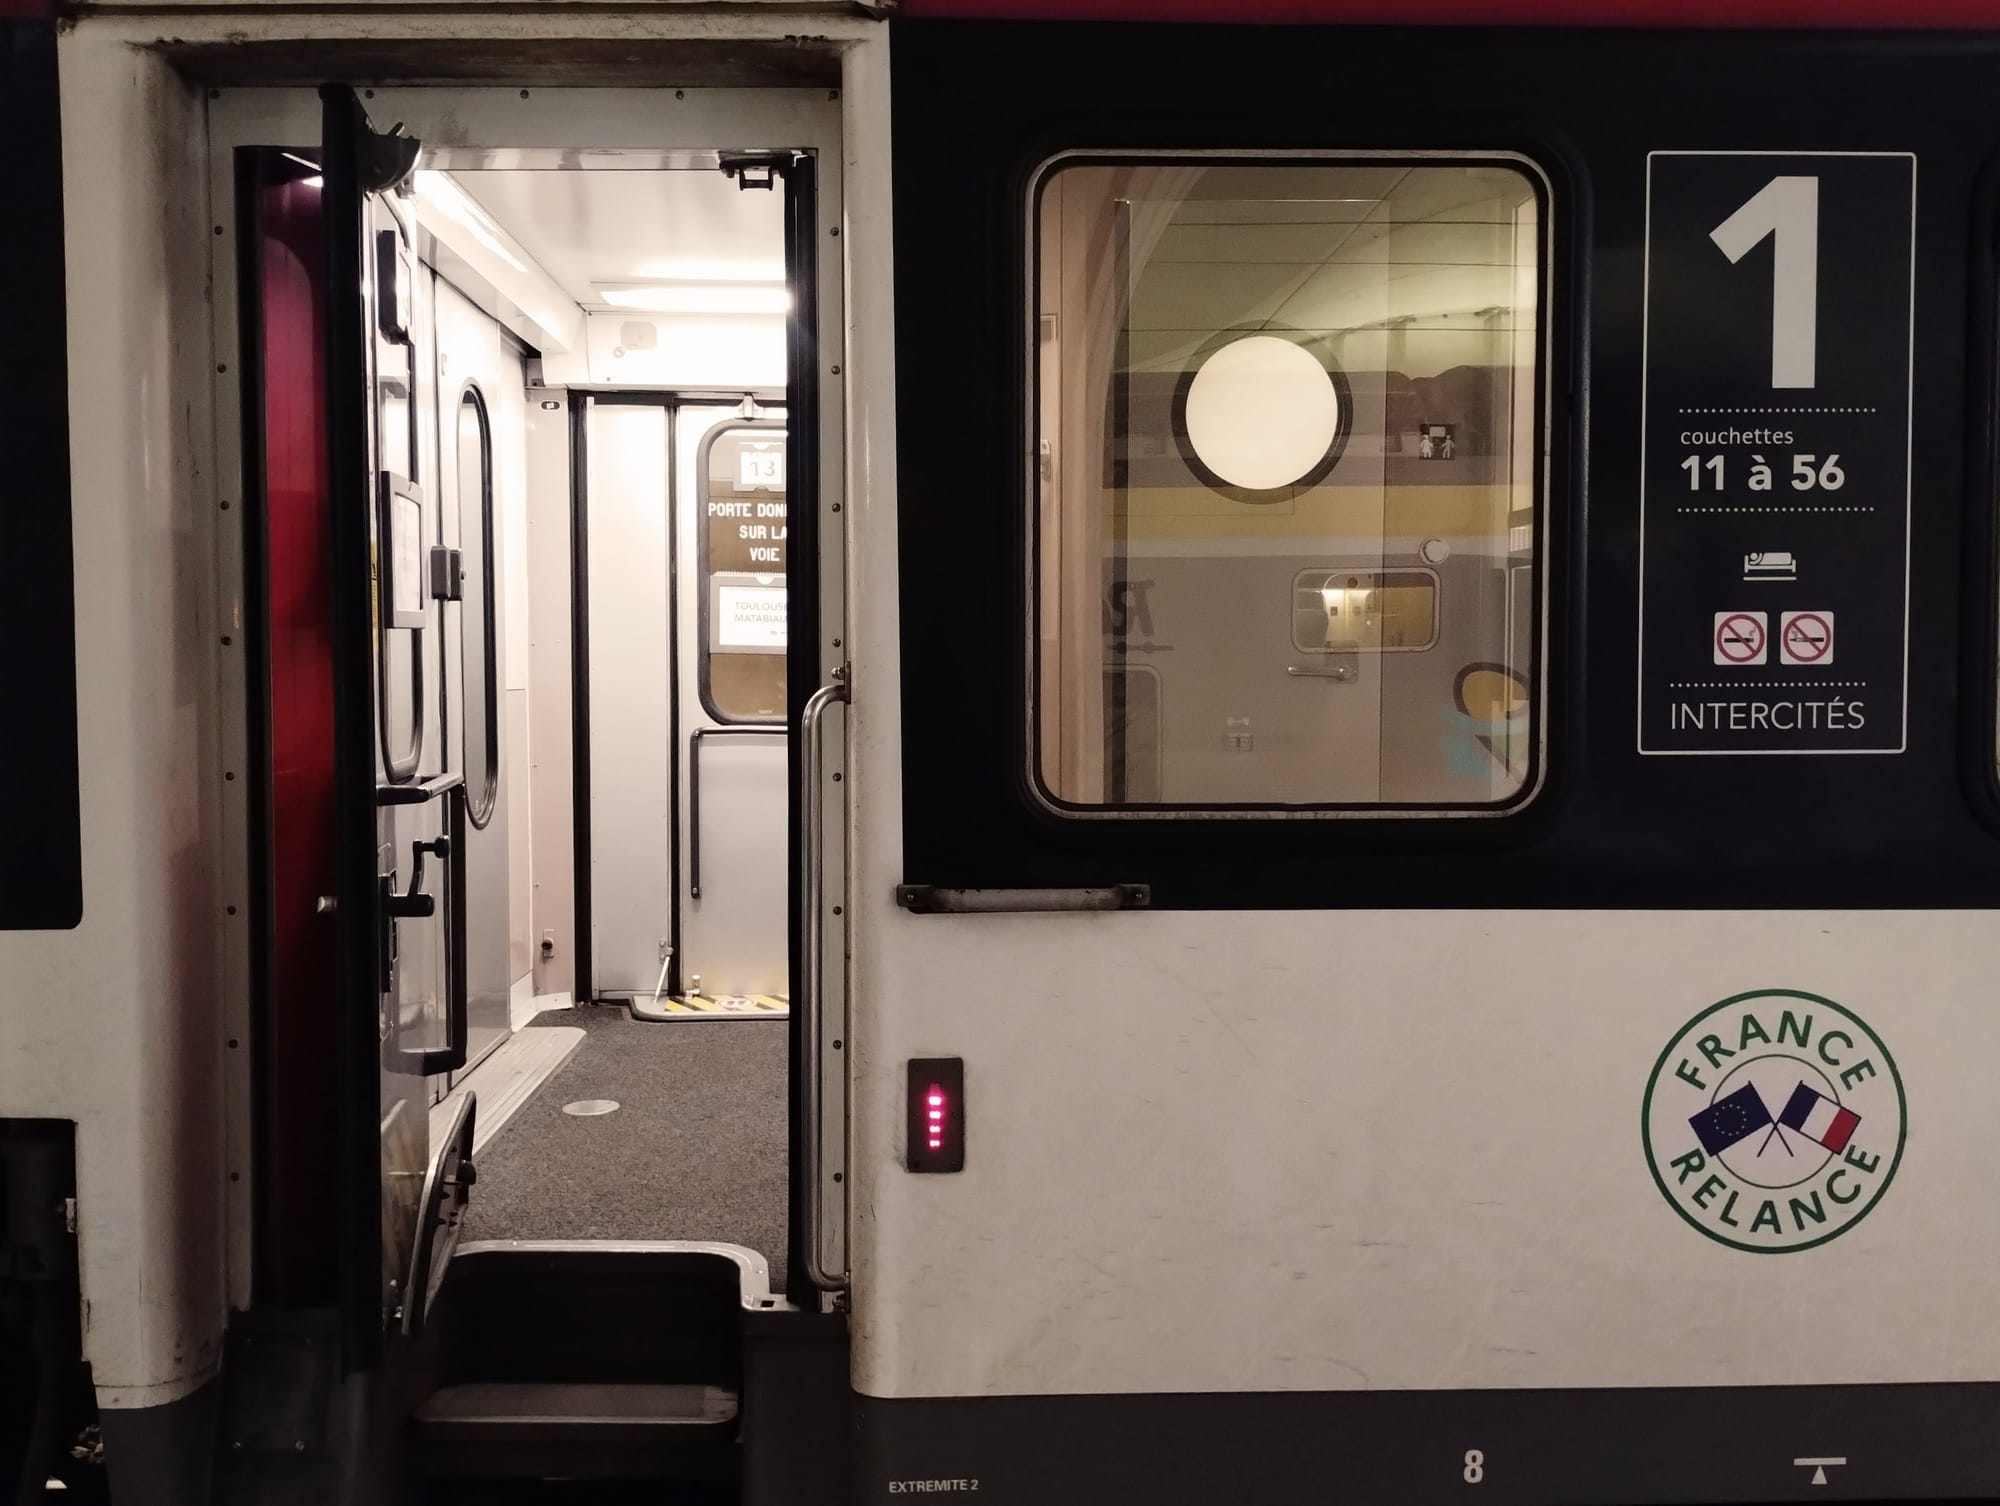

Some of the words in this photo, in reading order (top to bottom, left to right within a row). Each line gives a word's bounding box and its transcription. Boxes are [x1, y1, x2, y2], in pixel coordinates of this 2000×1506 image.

[1709, 176, 1819, 388] 1
[1680, 427, 1794, 445] couchettes
[749, 460, 776, 477] 13
[1681, 455, 1725, 491] 11
[1748, 455, 1772, 491] à
[1791, 454, 1845, 491] 56
[708, 502, 752, 518] PORTE
[757, 503, 787, 518] DON
[739, 525, 766, 540] SUR
[750, 547, 780, 562] VOIE
[735, 601, 787, 612] TOULOUS
[1671, 696, 1865, 730] INTERCITÉS
[1675, 1010, 1877, 1091] FRANCE
[1670, 1144, 1881, 1234] RELANCE
[1463, 1445, 1484, 1484] 8
[888, 1479, 968, 1493] EXTREMITE
[971, 1479, 979, 1491] 2
